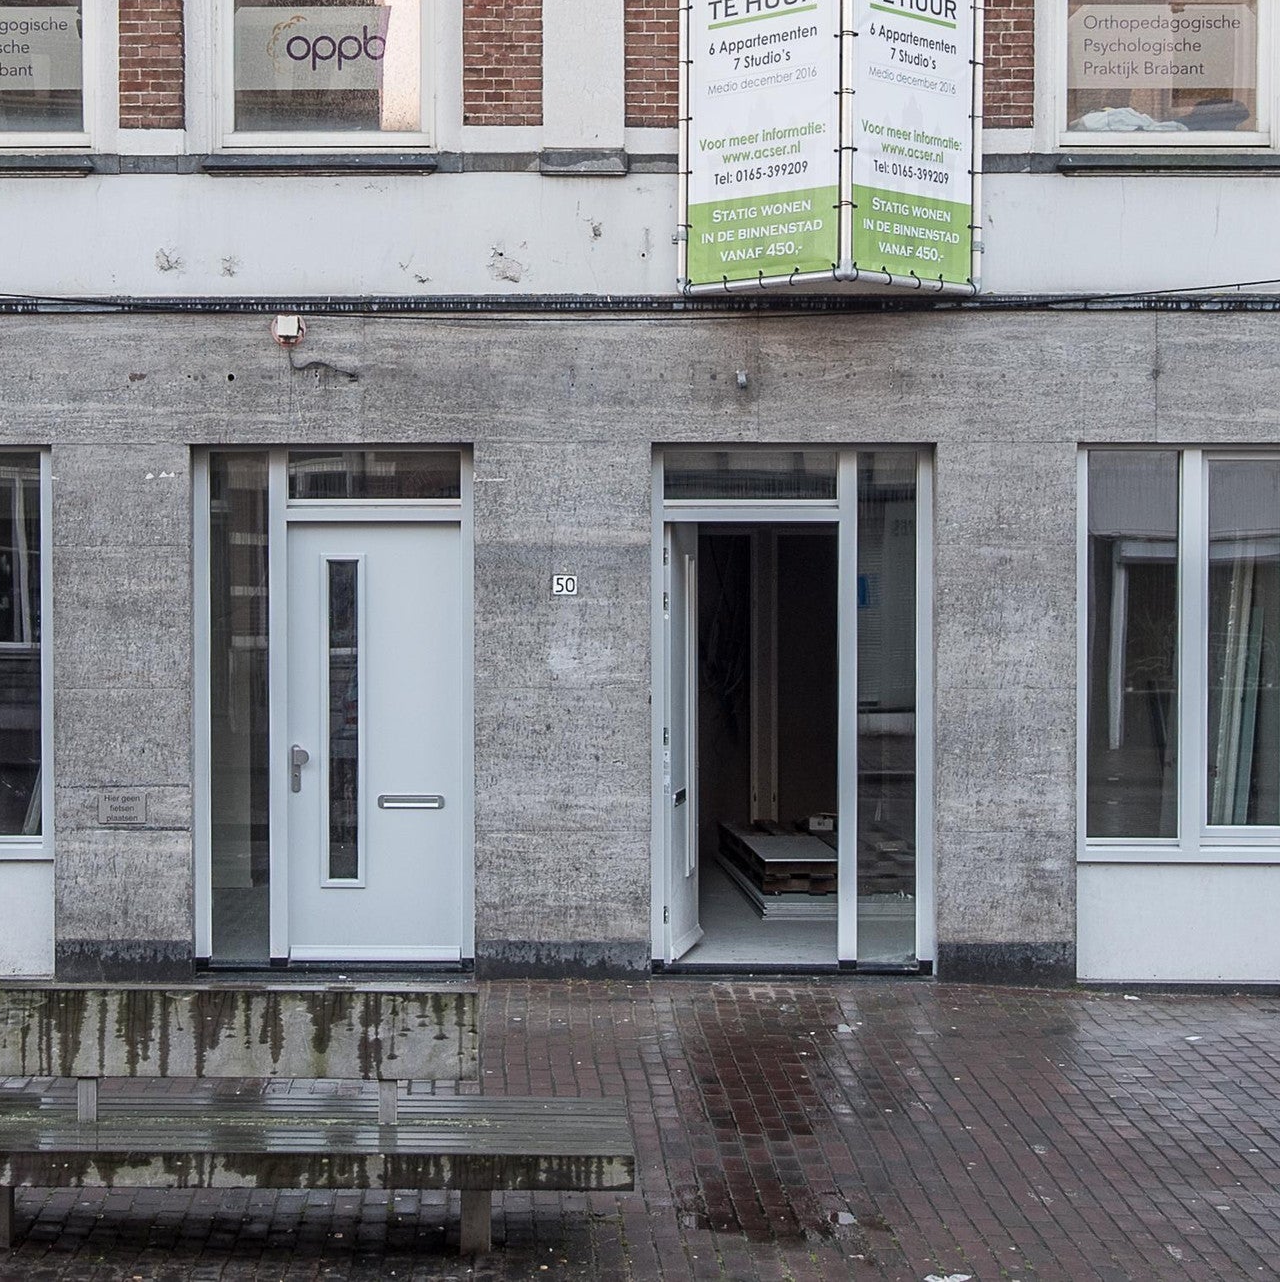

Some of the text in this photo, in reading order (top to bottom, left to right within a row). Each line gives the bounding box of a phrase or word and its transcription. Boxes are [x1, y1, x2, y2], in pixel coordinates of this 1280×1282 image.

[1083, 15, 1241, 33] Orthopedagogische
[286, 25, 386, 71] oppb
[708, 25, 818, 55] 6 Appartementen
[870, 23, 957, 55] 6 Appartementen
[1083, 37, 1202, 55] Psychologische
[734, 49, 791, 70] 7 Studio's
[890, 48, 936, 70] 7 Studio's
[1083, 60, 1205, 79] Praktijk Brabant
[708, 67, 818, 96] Medio december 2016
[869, 66, 956, 94] Medio december 2016
[699, 122, 826, 152] Voor meer informatie:
[861, 119, 962, 151] Voor meer informatie:
[722, 141, 801, 164] www.acser.nl
[881, 142, 944, 164] www.acser.nl
[714, 161, 808, 185] Tel: 0165-399209
[874, 159, 949, 184] Tel: 0165-399209
[761, 199, 811, 216] WONEN
[912, 206, 951, 223] WONEN
[701, 219, 823, 244] IN DE BINNENSTAD
[863, 218, 960, 244] IN DE BINNENSTAD
[720, 241, 803, 263] VANAF 450,-
[878, 242, 944, 264] VANAF 450,-
[555, 577, 575, 593] 50
